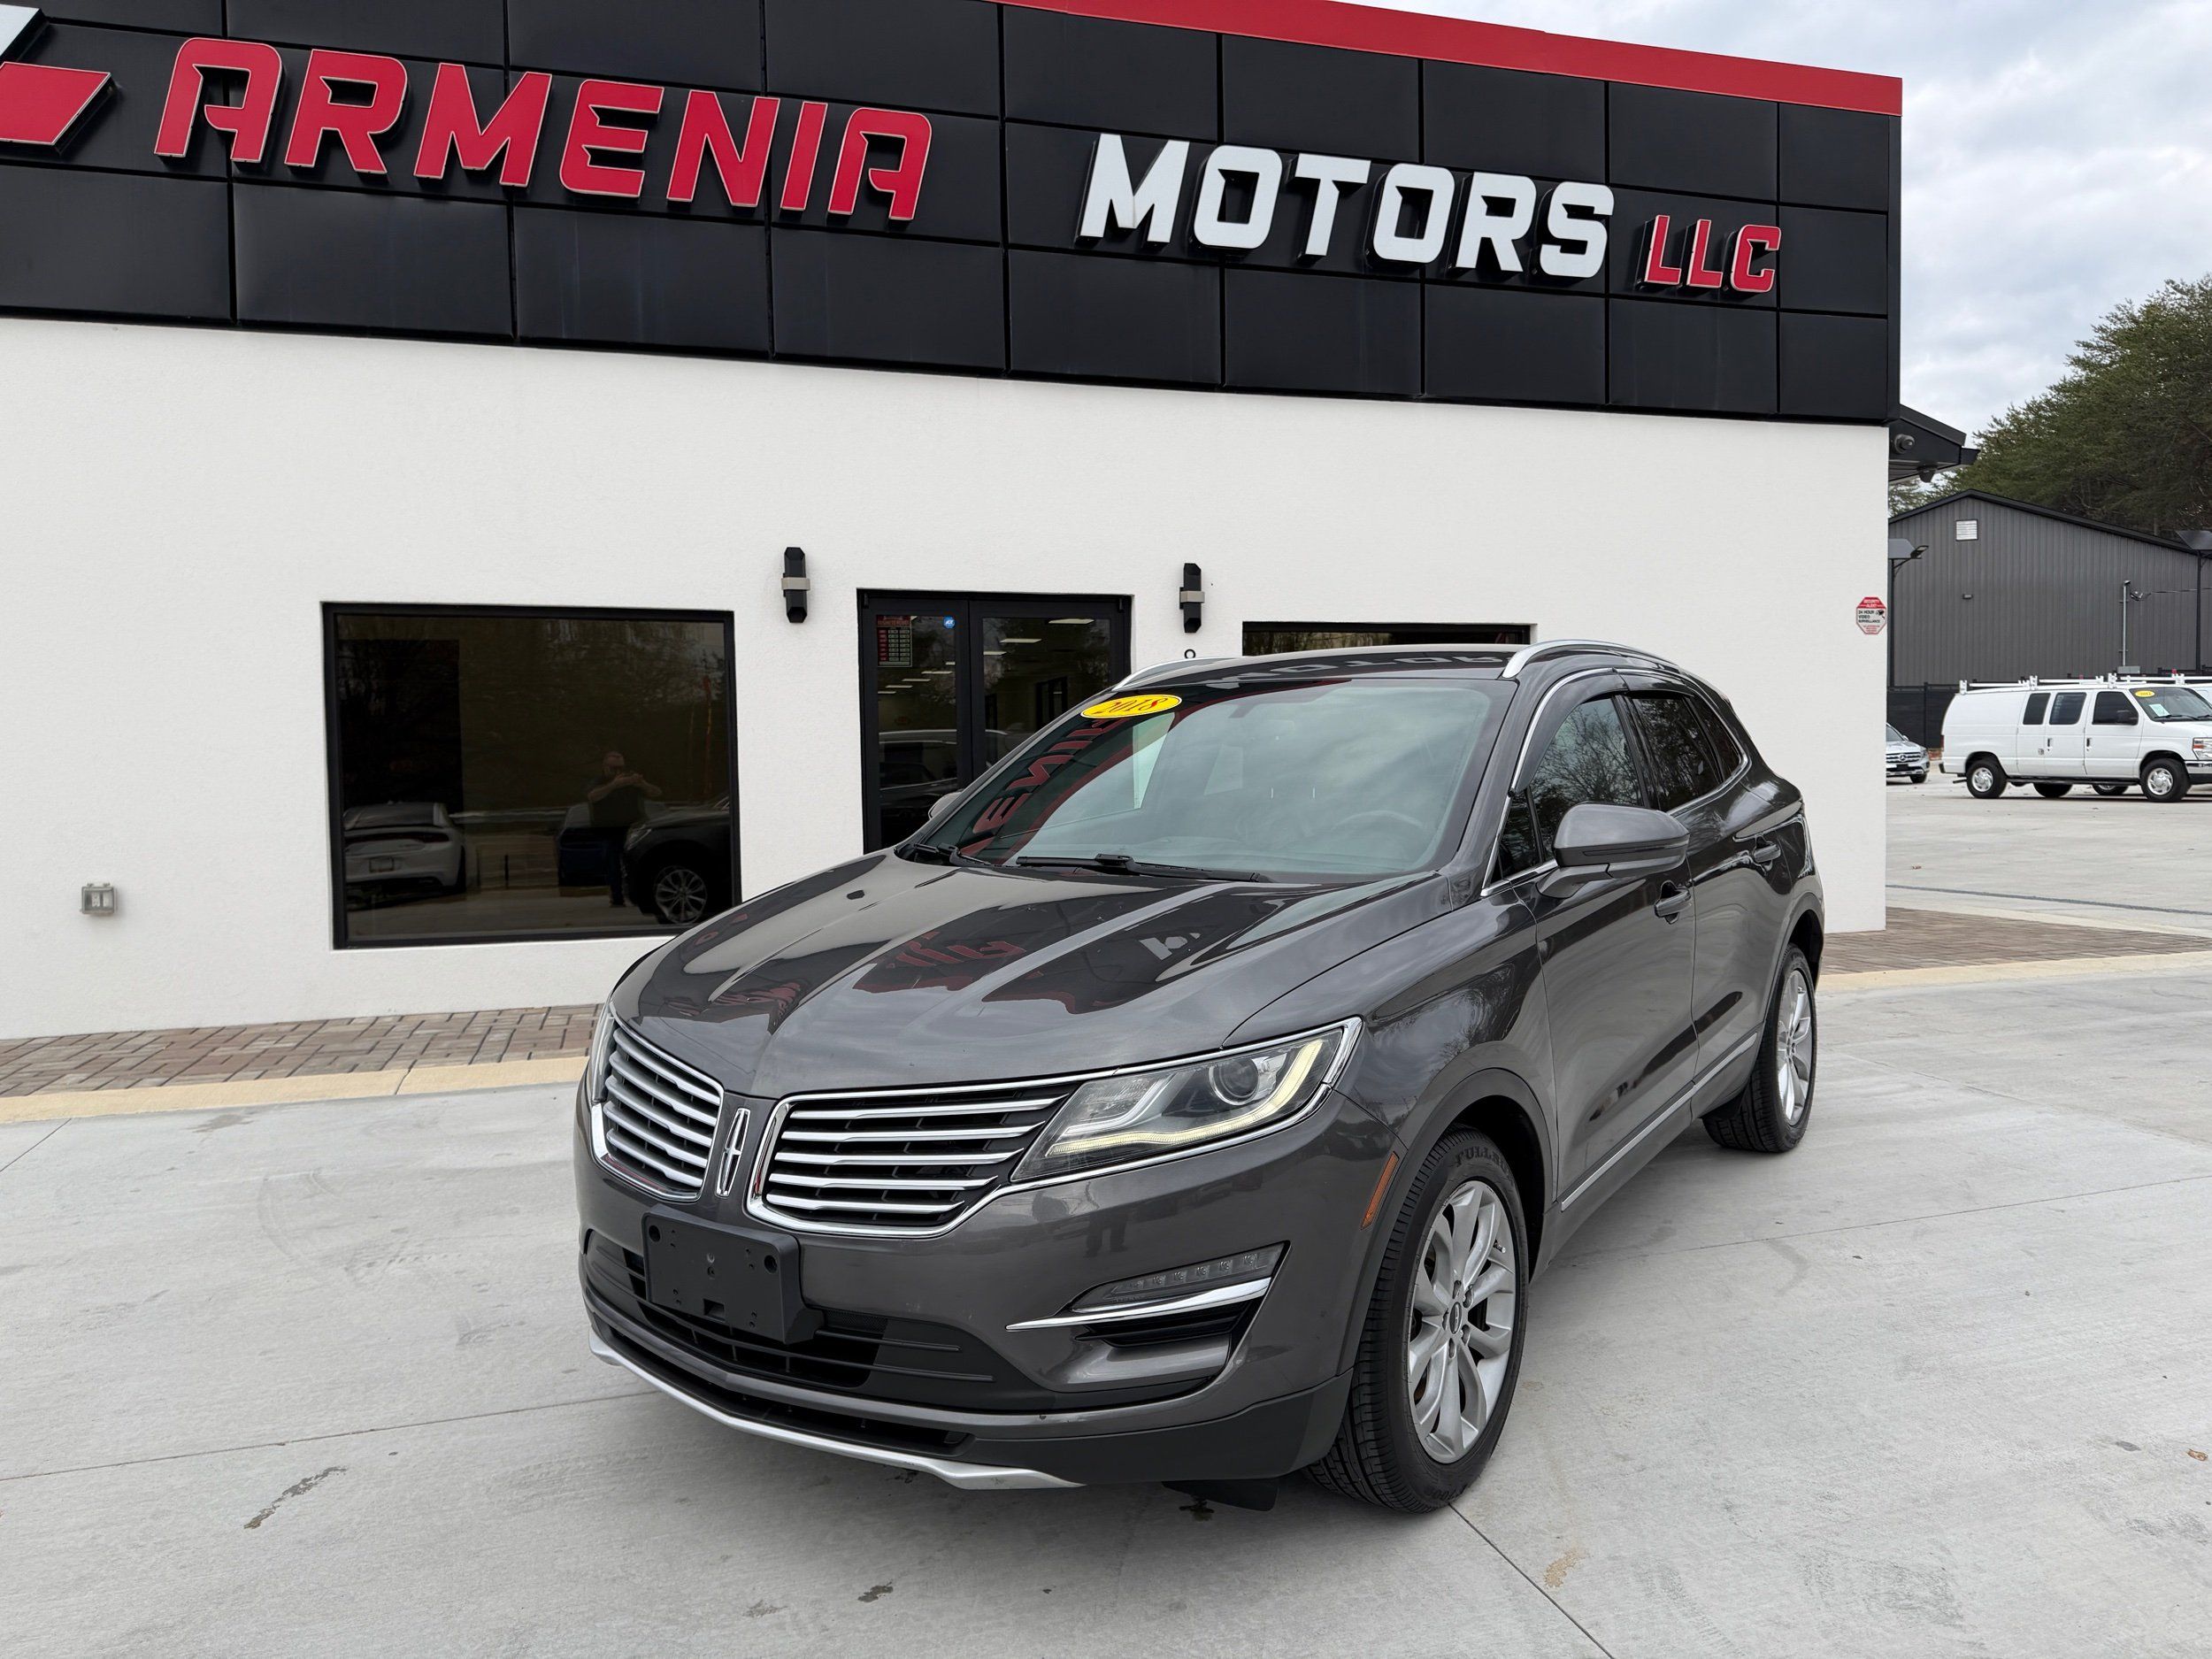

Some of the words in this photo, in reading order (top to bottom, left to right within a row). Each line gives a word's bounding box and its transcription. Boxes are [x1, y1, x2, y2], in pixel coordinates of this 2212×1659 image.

[154, 38, 932, 221] ARMENIA
[1079, 133, 1614, 279] MOTORS
[1644, 215, 1781, 294] LLC
[1091, 697, 1169, 715] 2018
